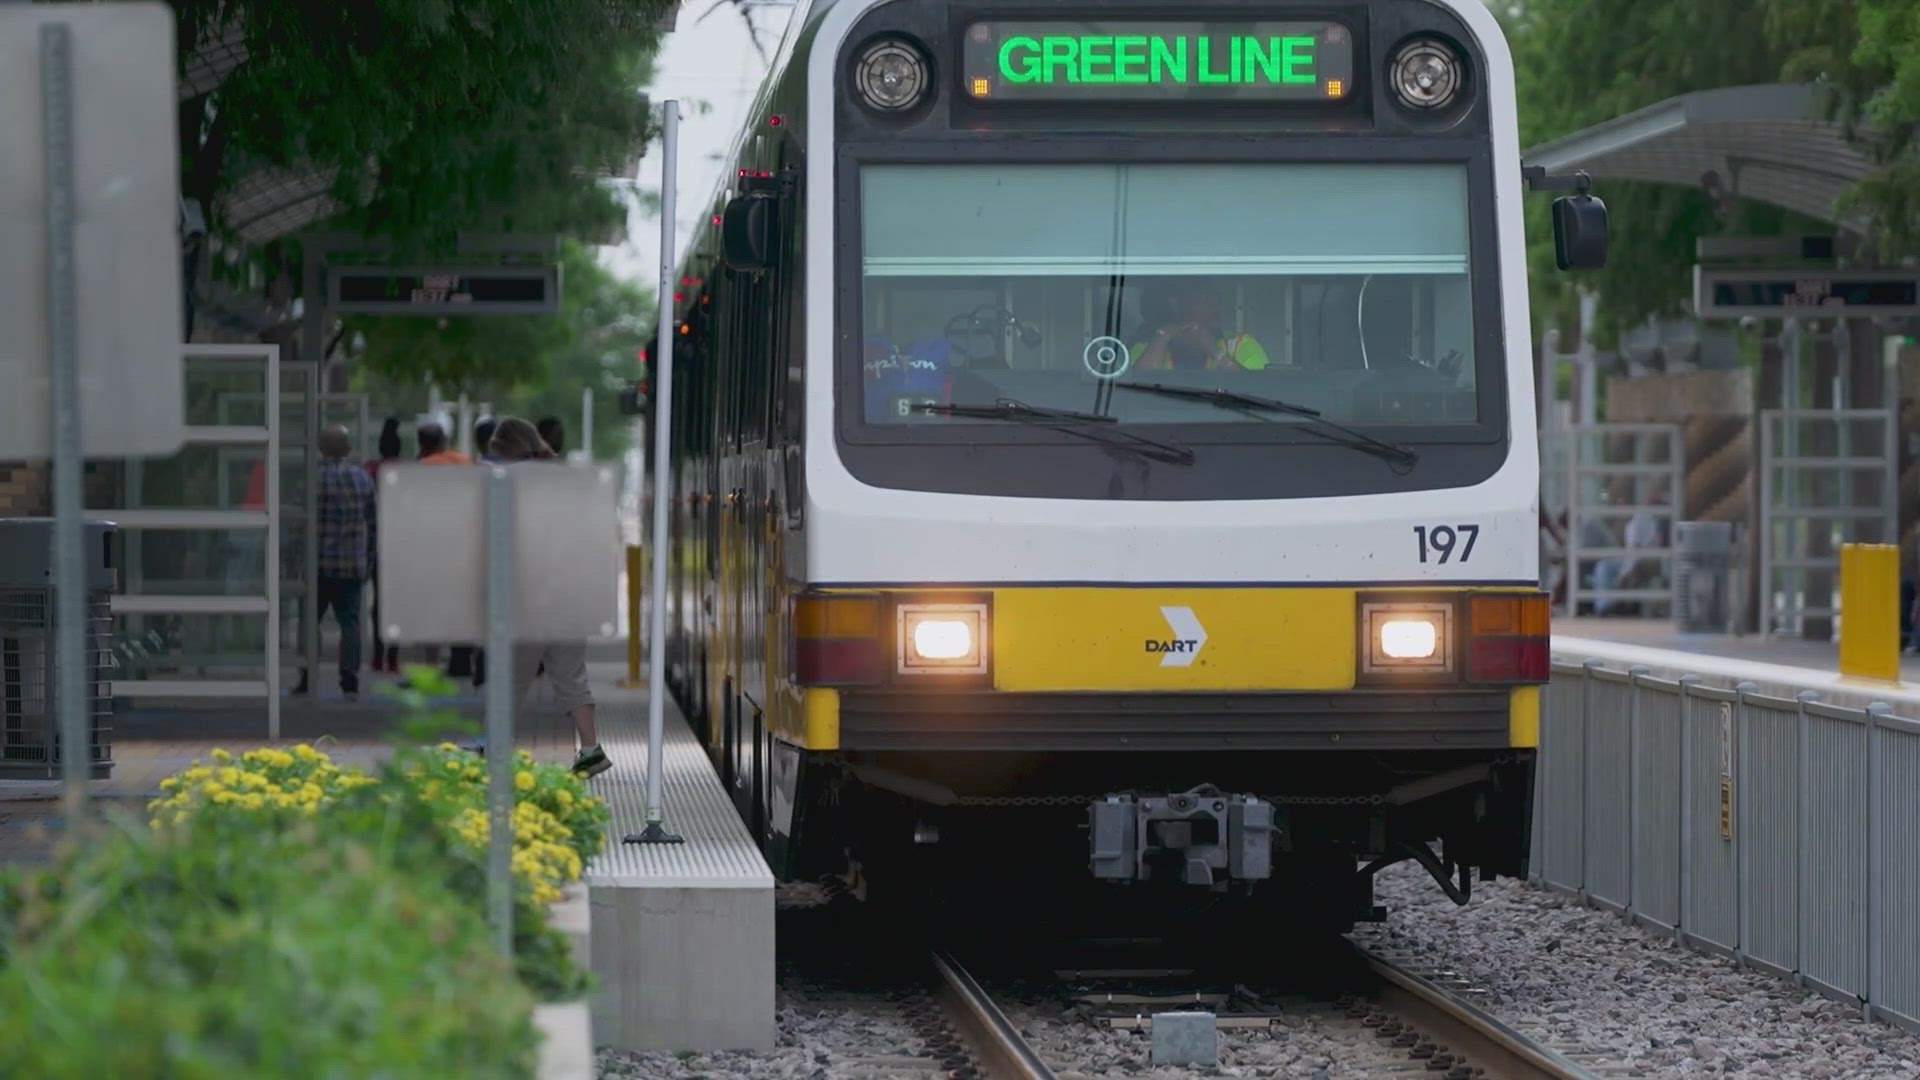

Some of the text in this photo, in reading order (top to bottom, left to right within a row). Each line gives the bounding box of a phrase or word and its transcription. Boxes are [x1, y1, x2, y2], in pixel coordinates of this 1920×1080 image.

[999, 36, 1317, 83] GREEN LINE
[1413, 524, 1479, 565] 197
[1145, 639, 1198, 653] DART
